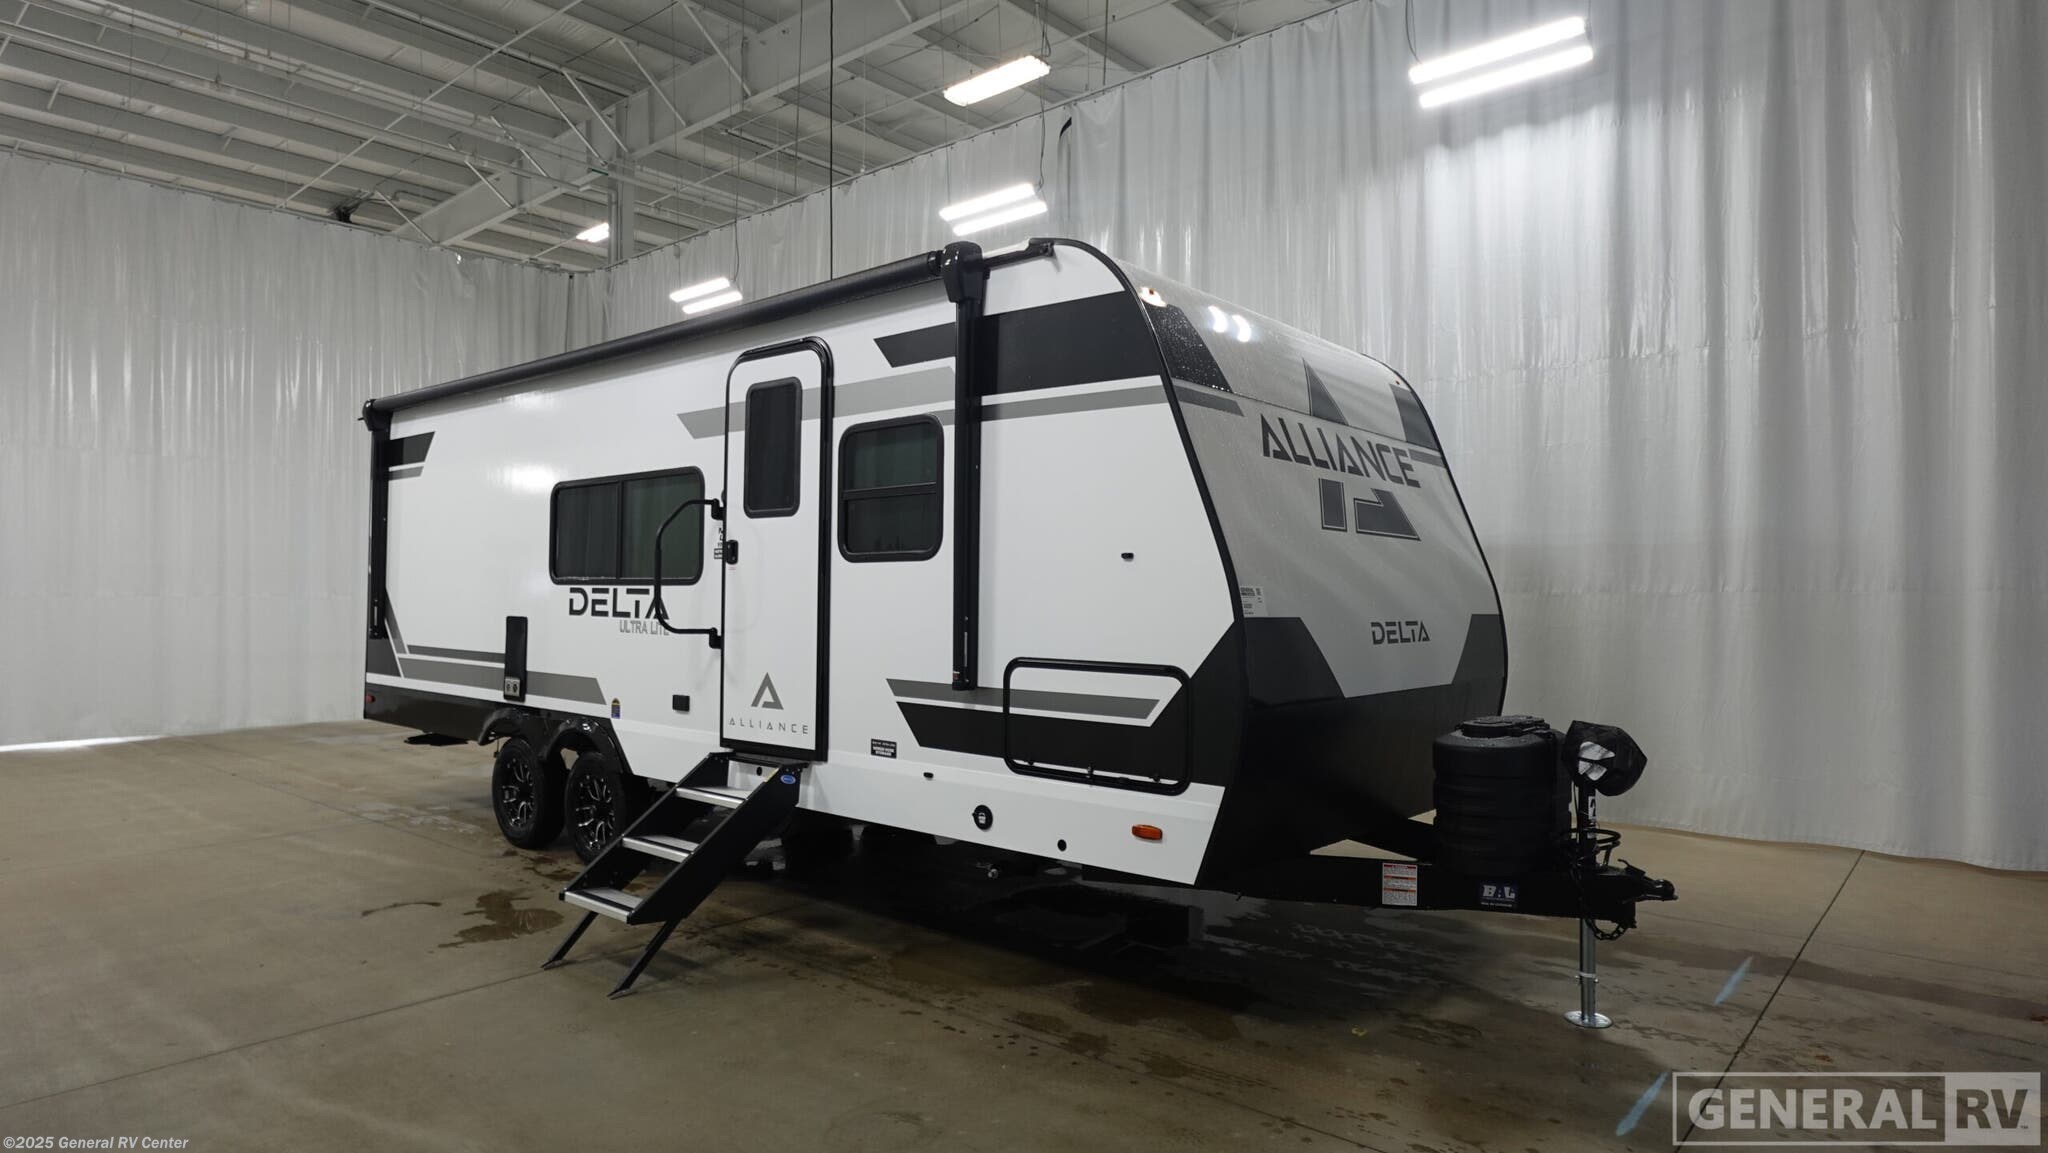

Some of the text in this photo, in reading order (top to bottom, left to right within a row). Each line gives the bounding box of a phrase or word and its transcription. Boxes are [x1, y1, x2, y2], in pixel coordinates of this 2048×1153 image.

[1260, 414, 1421, 488] ALLIANCE
[569, 587, 670, 620] DELTA
[619, 619, 648, 635] ULTRA
[1370, 620, 1431, 645] DELTA
[729, 717, 809, 734] ALLIANCE
